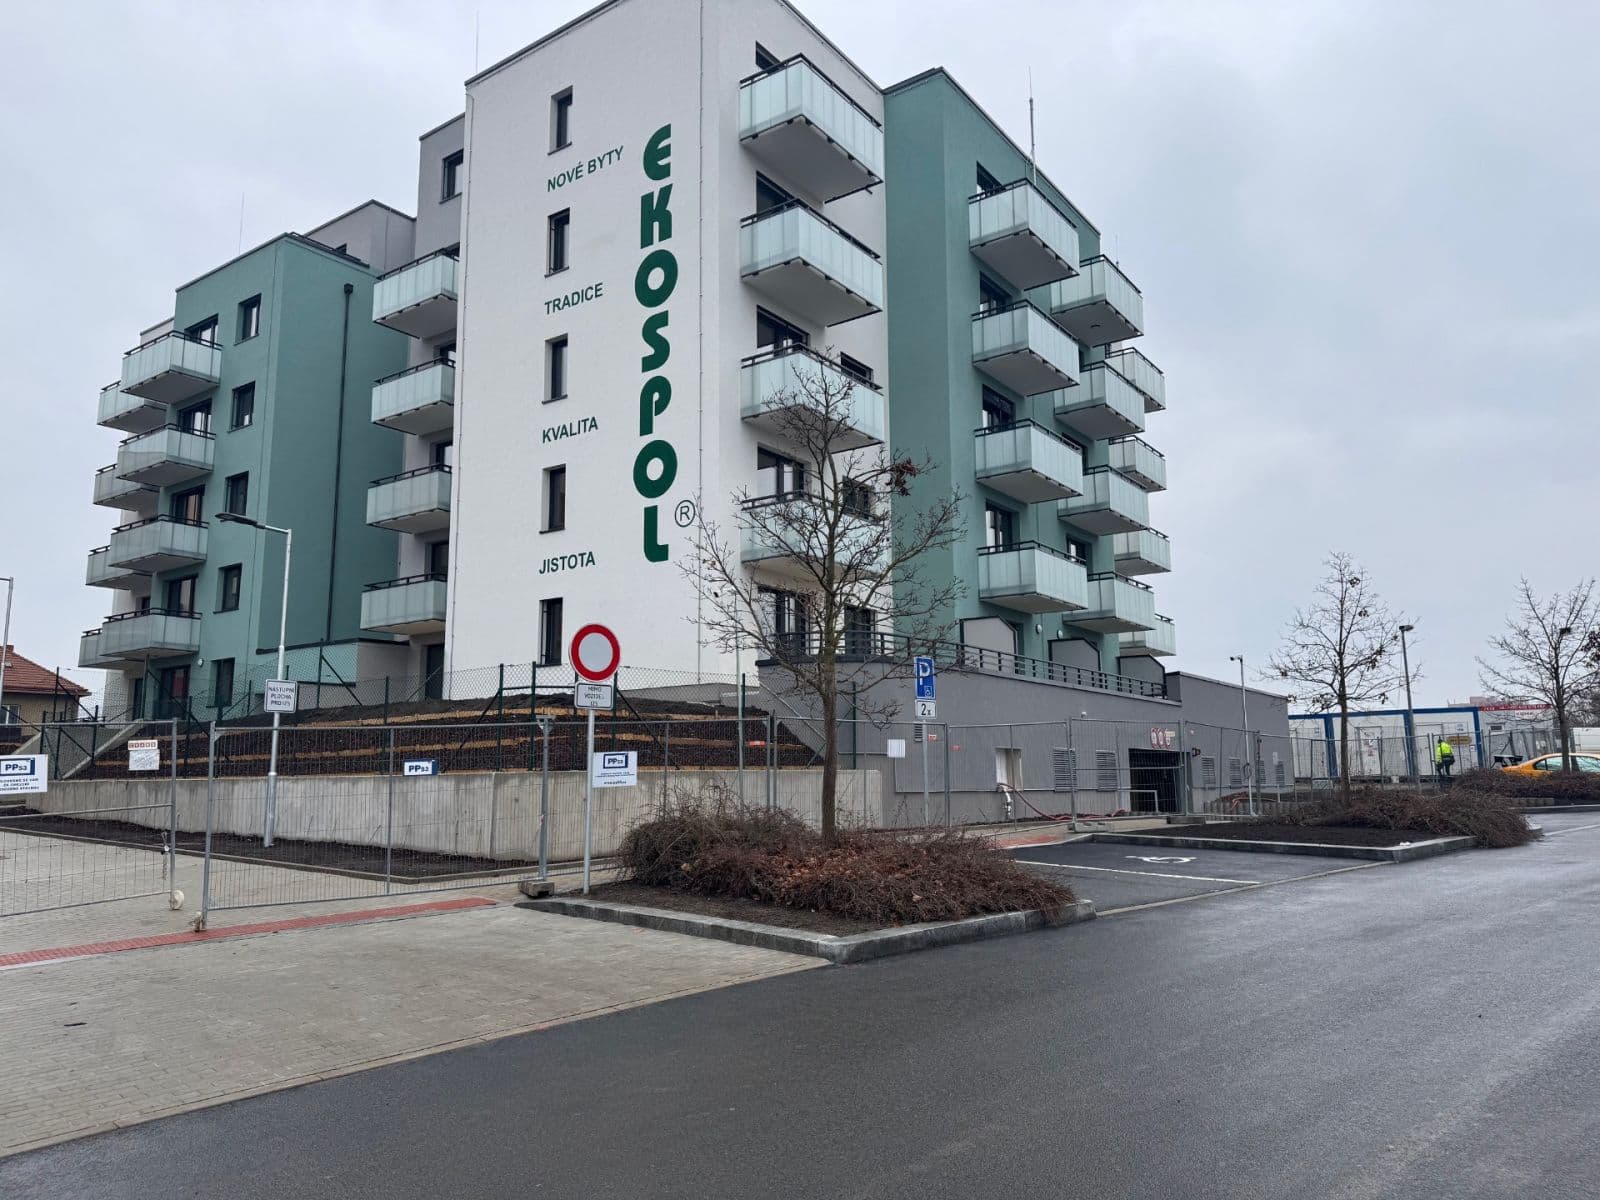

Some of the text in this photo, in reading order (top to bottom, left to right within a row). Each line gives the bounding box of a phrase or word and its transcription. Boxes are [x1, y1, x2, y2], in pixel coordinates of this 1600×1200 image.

[547, 145, 624, 192] NOVÉ BYTY
[544, 282, 604, 315] TRADICE
[633, 123, 678, 562] EKOSPOL
[542, 416, 599, 444] KVALITA
[539, 551, 596, 574] JISTOTA
[920, 662, 931, 685] P
